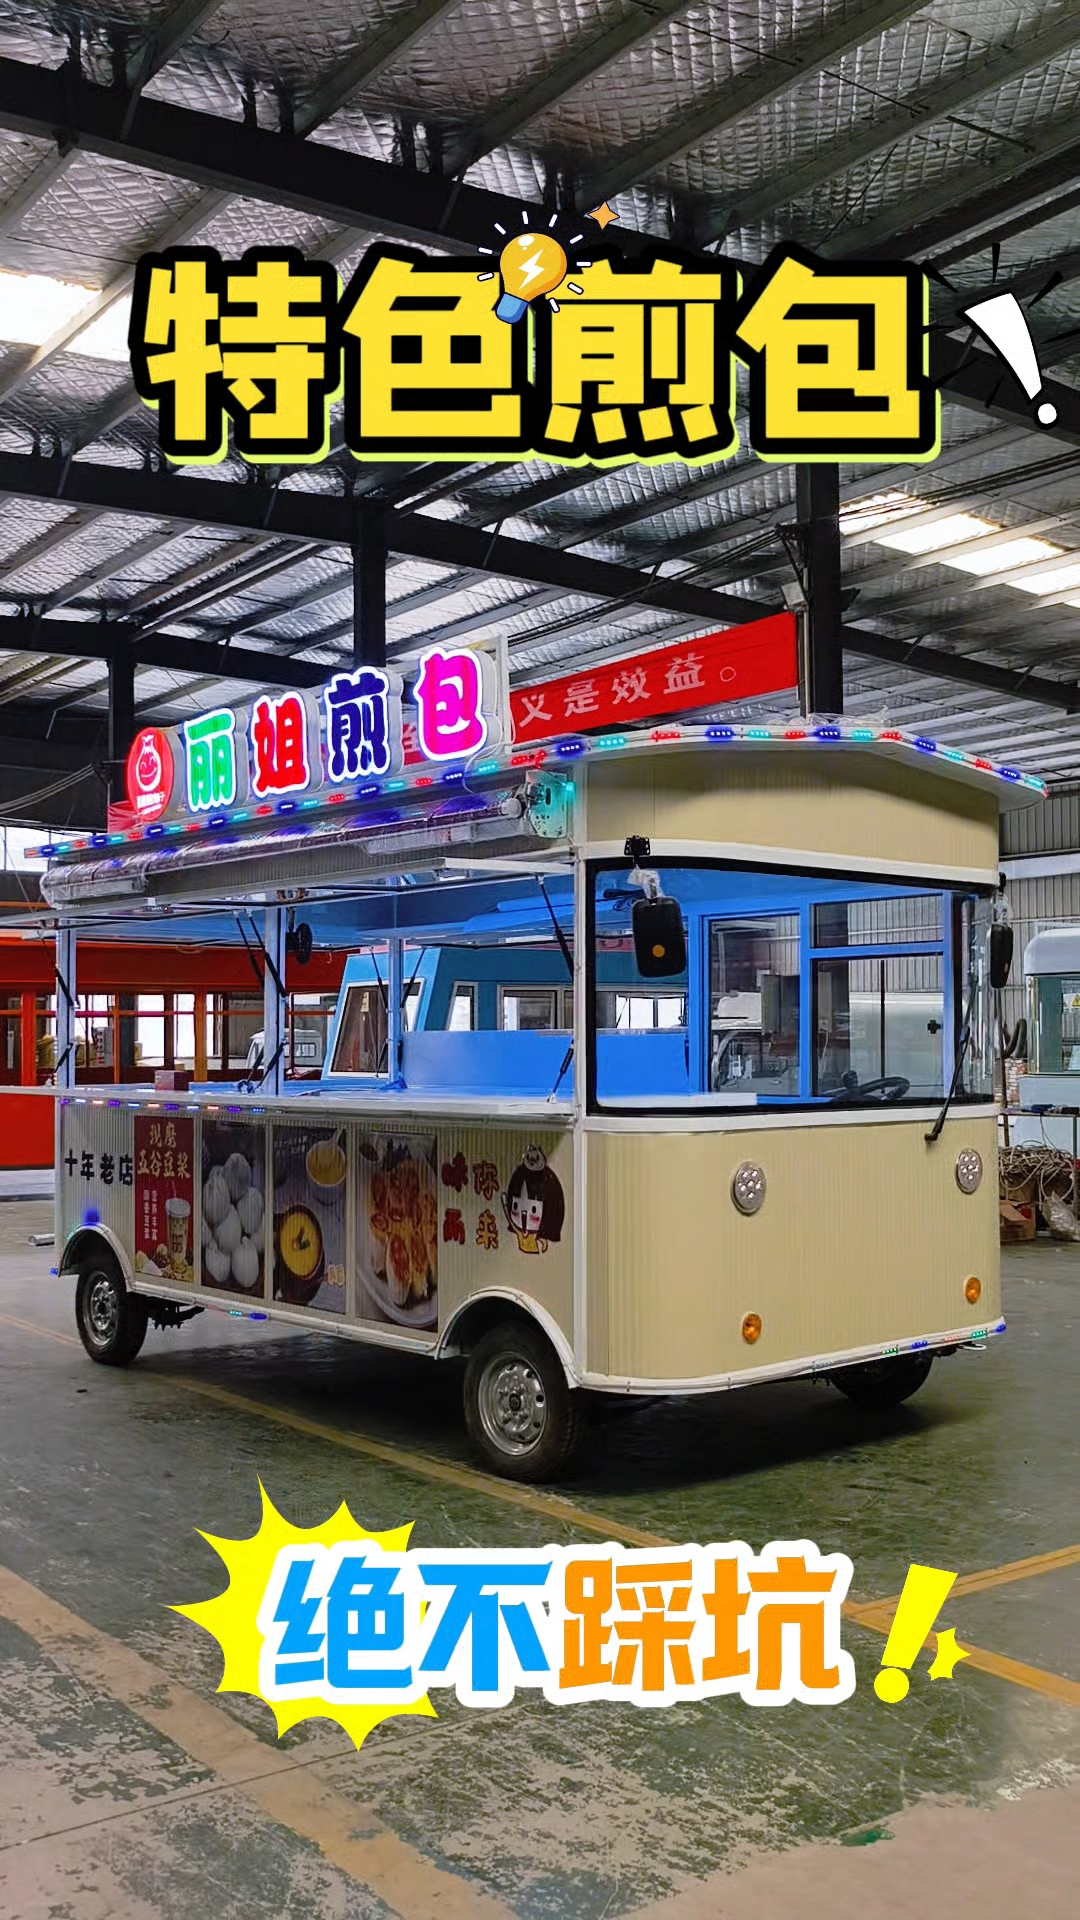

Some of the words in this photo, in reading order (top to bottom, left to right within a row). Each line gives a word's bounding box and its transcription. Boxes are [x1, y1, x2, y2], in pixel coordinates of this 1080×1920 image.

[184, 648, 488, 812] 丽姐煎包
[64, 1148, 133, 1187] 十年老店
